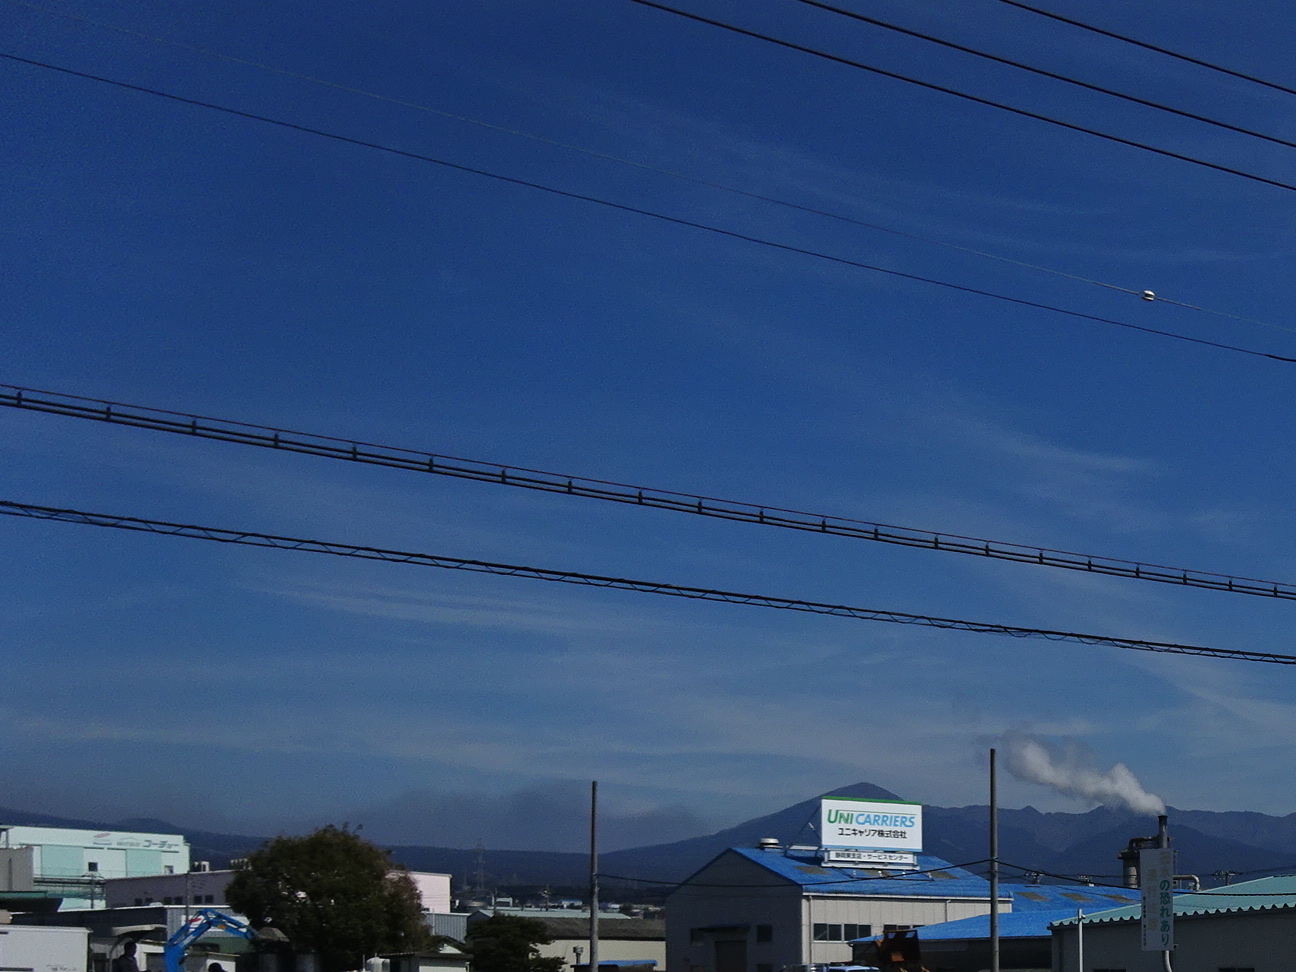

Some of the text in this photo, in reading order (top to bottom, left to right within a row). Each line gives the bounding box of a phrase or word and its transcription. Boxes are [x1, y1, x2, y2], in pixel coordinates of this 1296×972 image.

[838, 828, 907, 839] ユニキャリア株式会社
